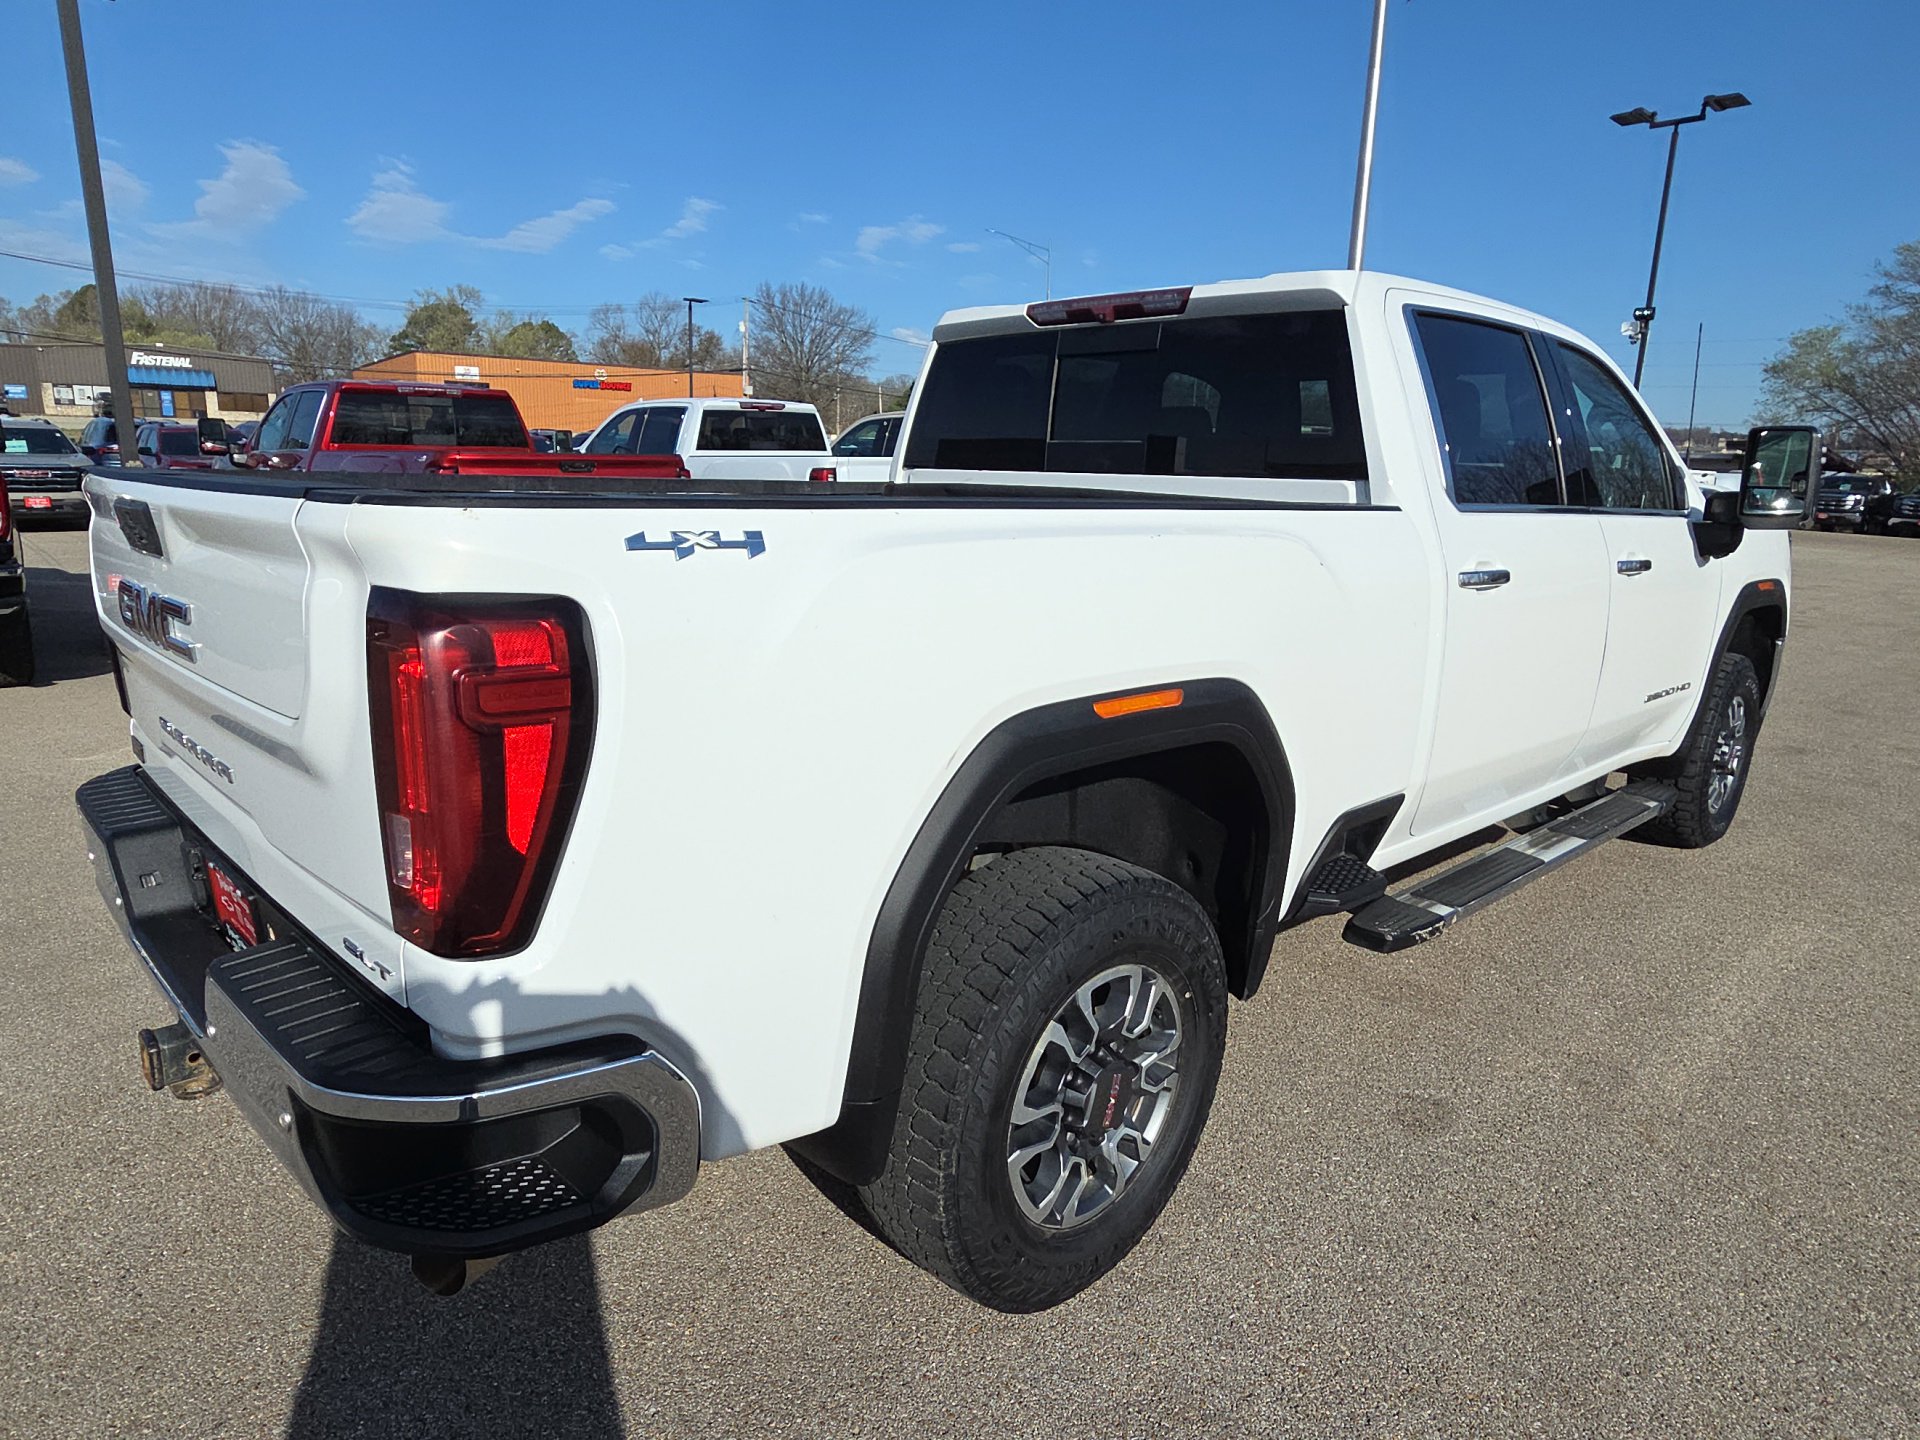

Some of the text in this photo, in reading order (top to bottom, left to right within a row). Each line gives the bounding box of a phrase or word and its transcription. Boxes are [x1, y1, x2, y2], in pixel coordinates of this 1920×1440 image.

[130, 351, 193, 368] FASTENAL
[118, 578, 200, 664] GMC
[159, 716, 235, 784] SIERRA
[343, 936, 397, 981] SLT
